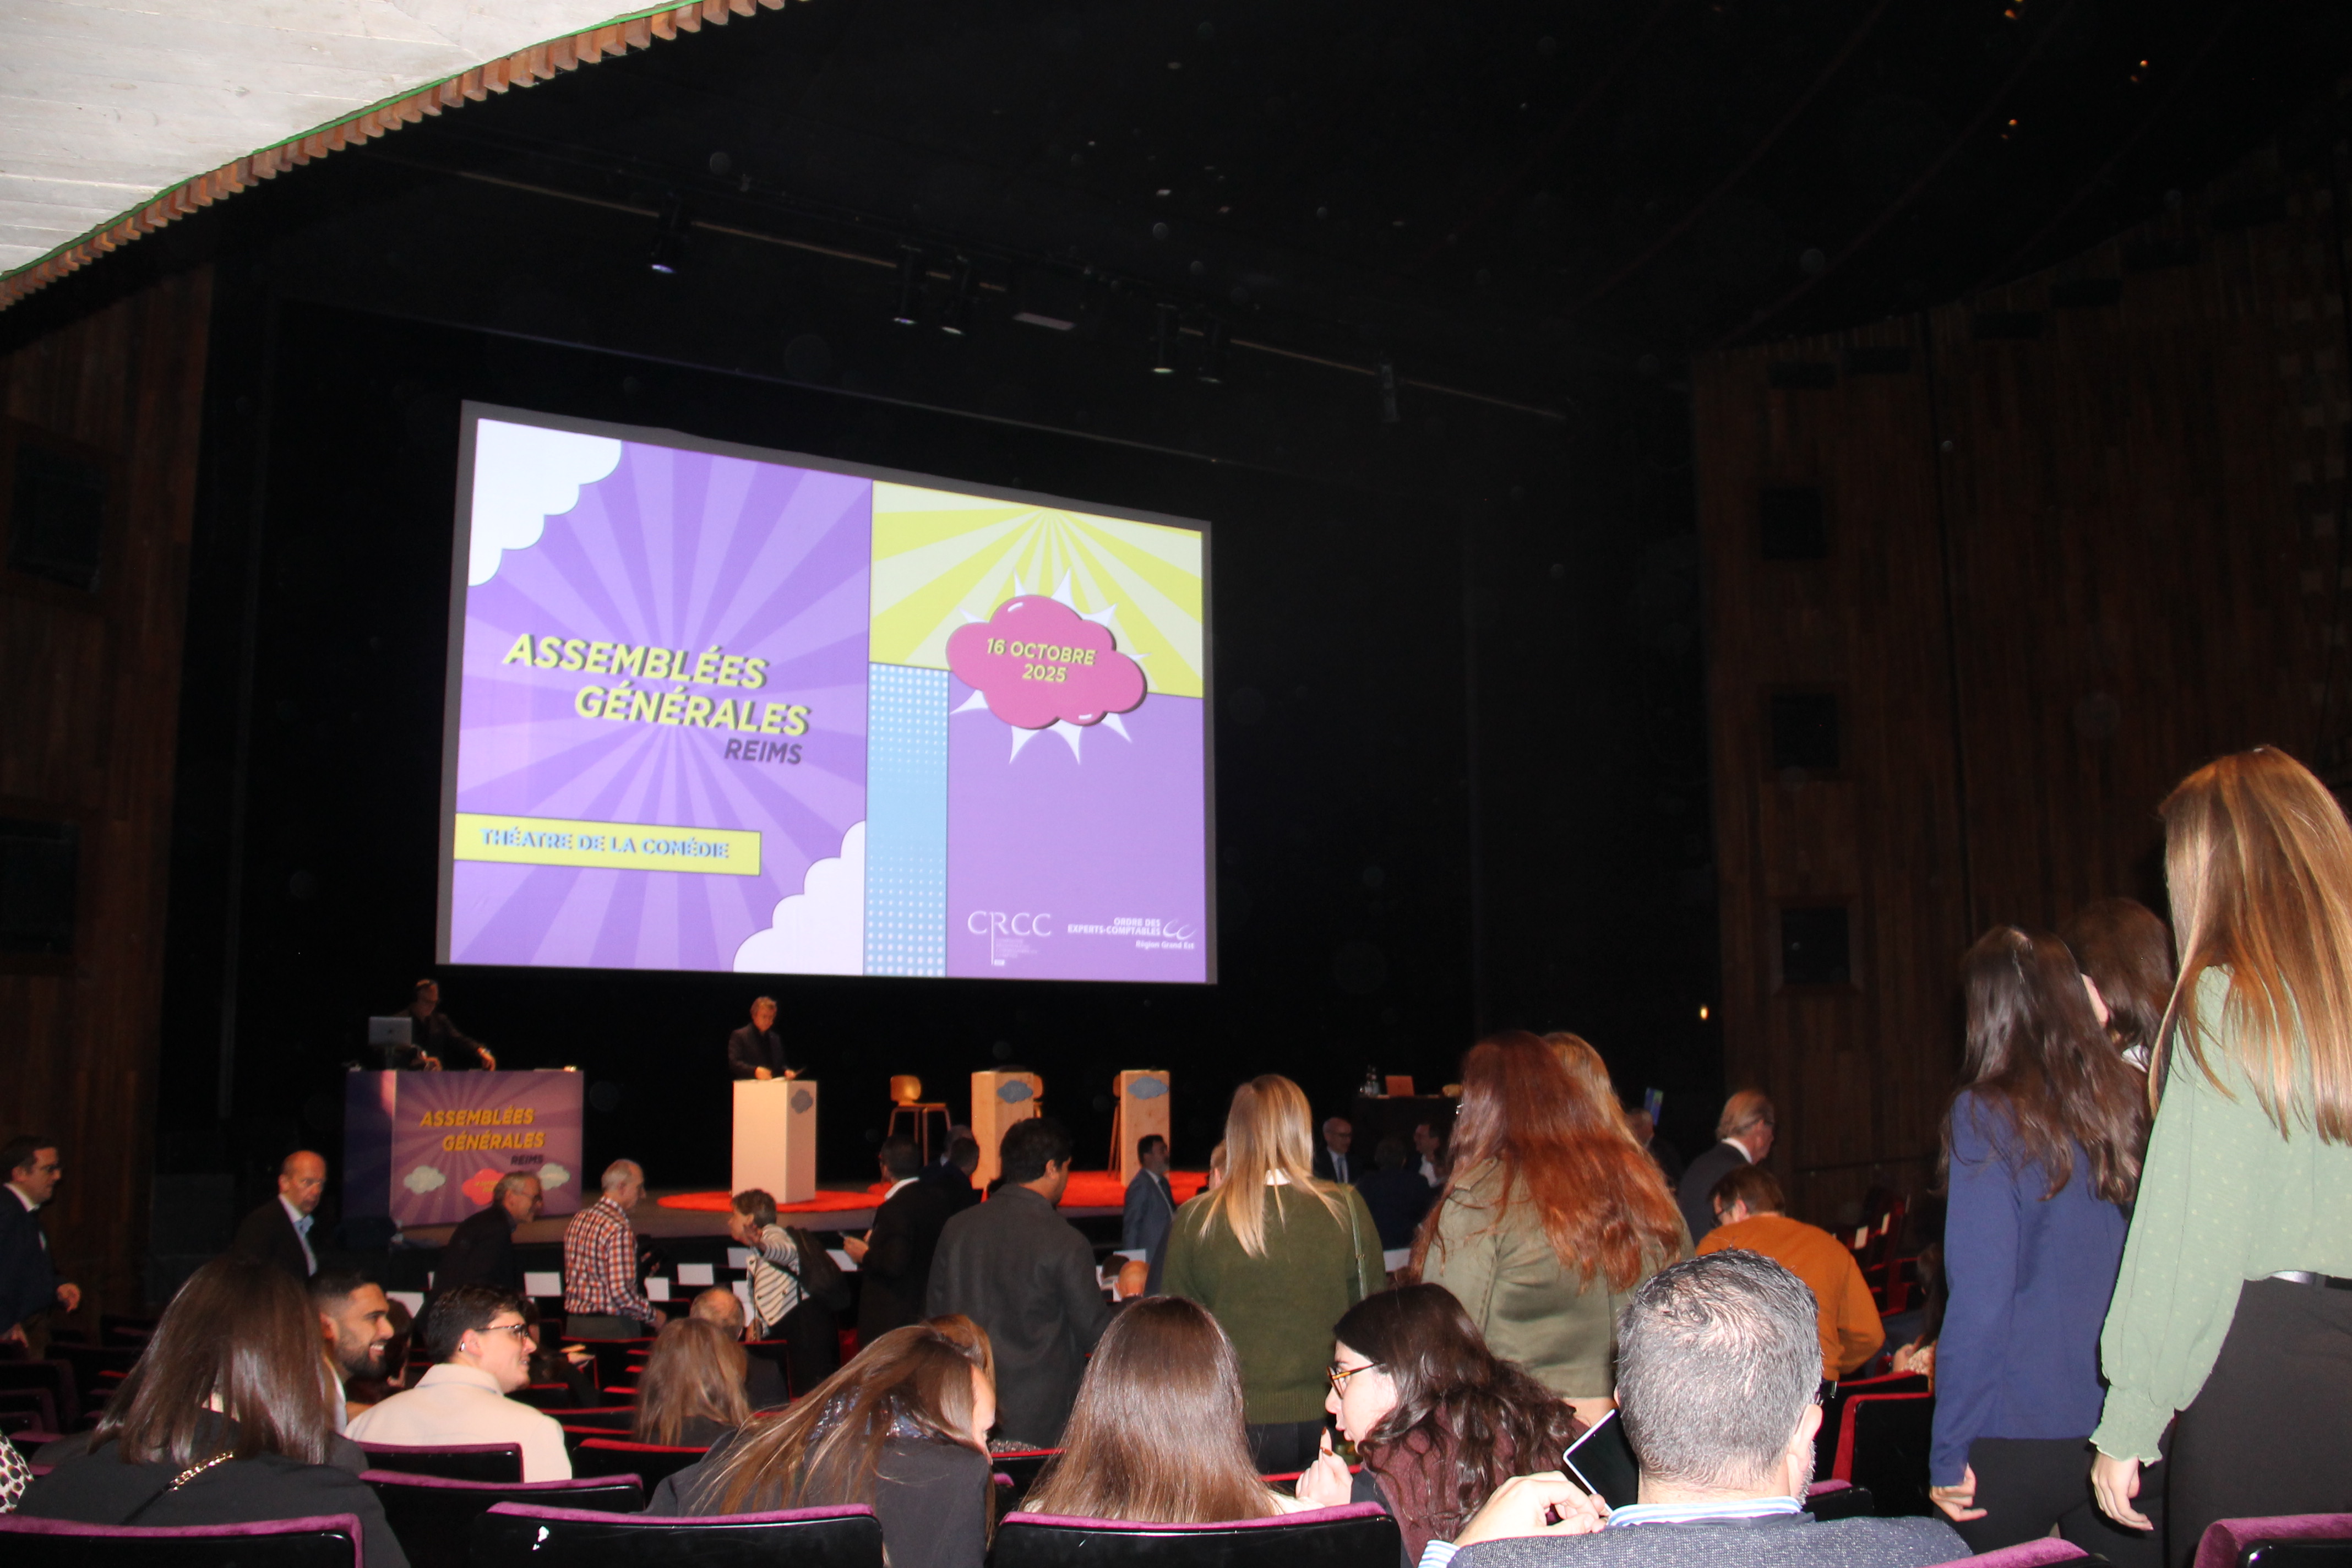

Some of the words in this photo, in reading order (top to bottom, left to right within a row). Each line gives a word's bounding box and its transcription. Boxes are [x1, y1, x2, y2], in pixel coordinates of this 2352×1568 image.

[502, 633, 770, 689] ASSEMBLÉES
[987, 638, 1006, 655] 16
[1010, 641, 1097, 666] OCTOBRE
[1022, 663, 1068, 683] 2025
[575, 680, 812, 736] GÉNÉRALES
[724, 738, 802, 765] REIMS
[576, 834, 605, 852] DE
[610, 836, 636, 853] LA
[641, 837, 729, 859] COMÉDIE
[967, 910, 1051, 937] CRCC
[1067, 924, 1161, 935] EXPERTS-COMPTABLES
[1113, 917, 1142, 926] ORDRE
[1145, 918, 1161, 927] DES
[1135, 940, 1159, 950] Région
[1161, 941, 1182, 949] Grand
[419, 1105, 535, 1127] ASSEMBLÉES
[442, 1130, 546, 1152] GÉNÉRALES
[510, 1153, 544, 1166] REIMS
